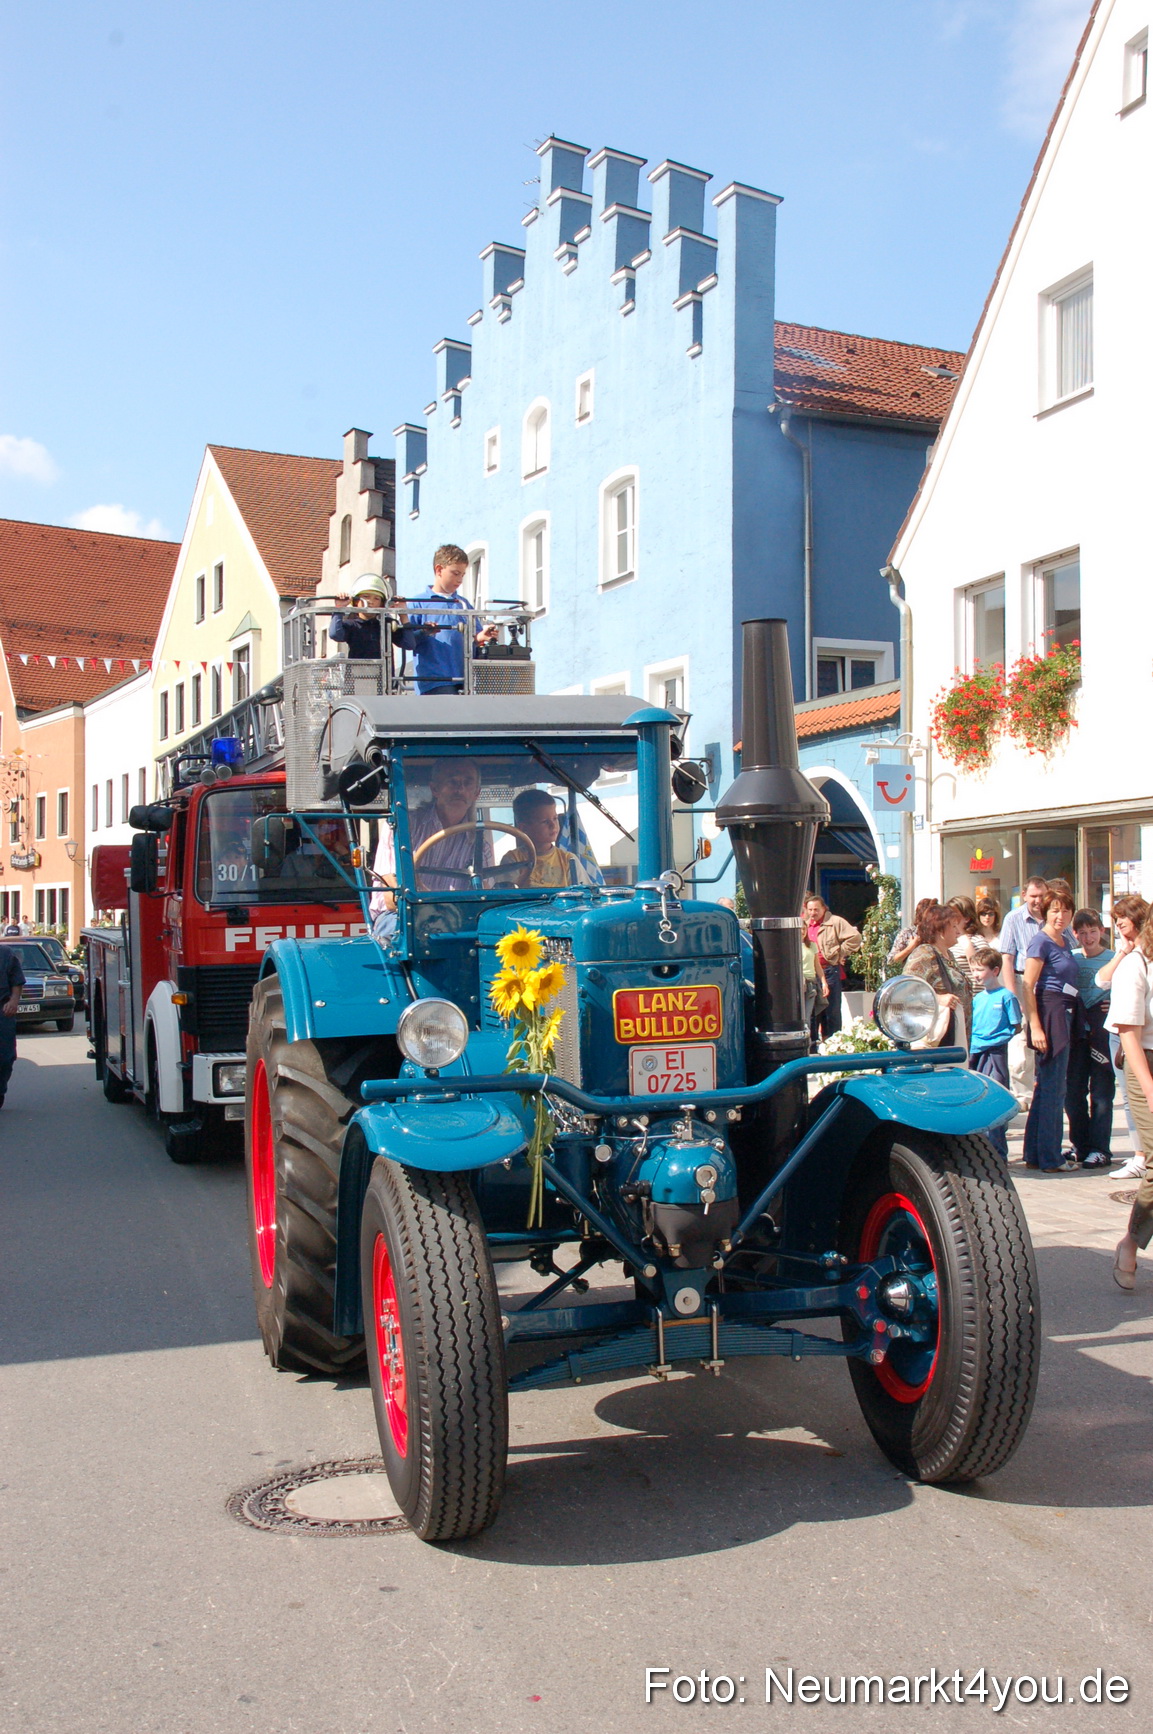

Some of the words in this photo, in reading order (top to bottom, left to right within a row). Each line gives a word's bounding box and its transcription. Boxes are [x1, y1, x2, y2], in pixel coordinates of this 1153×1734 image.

[638, 991, 699, 1014] LANZ
[619, 1014, 718, 1039] BULLDOG
[665, 1050, 685, 1071] EI
[647, 1072, 697, 1094] 0725
